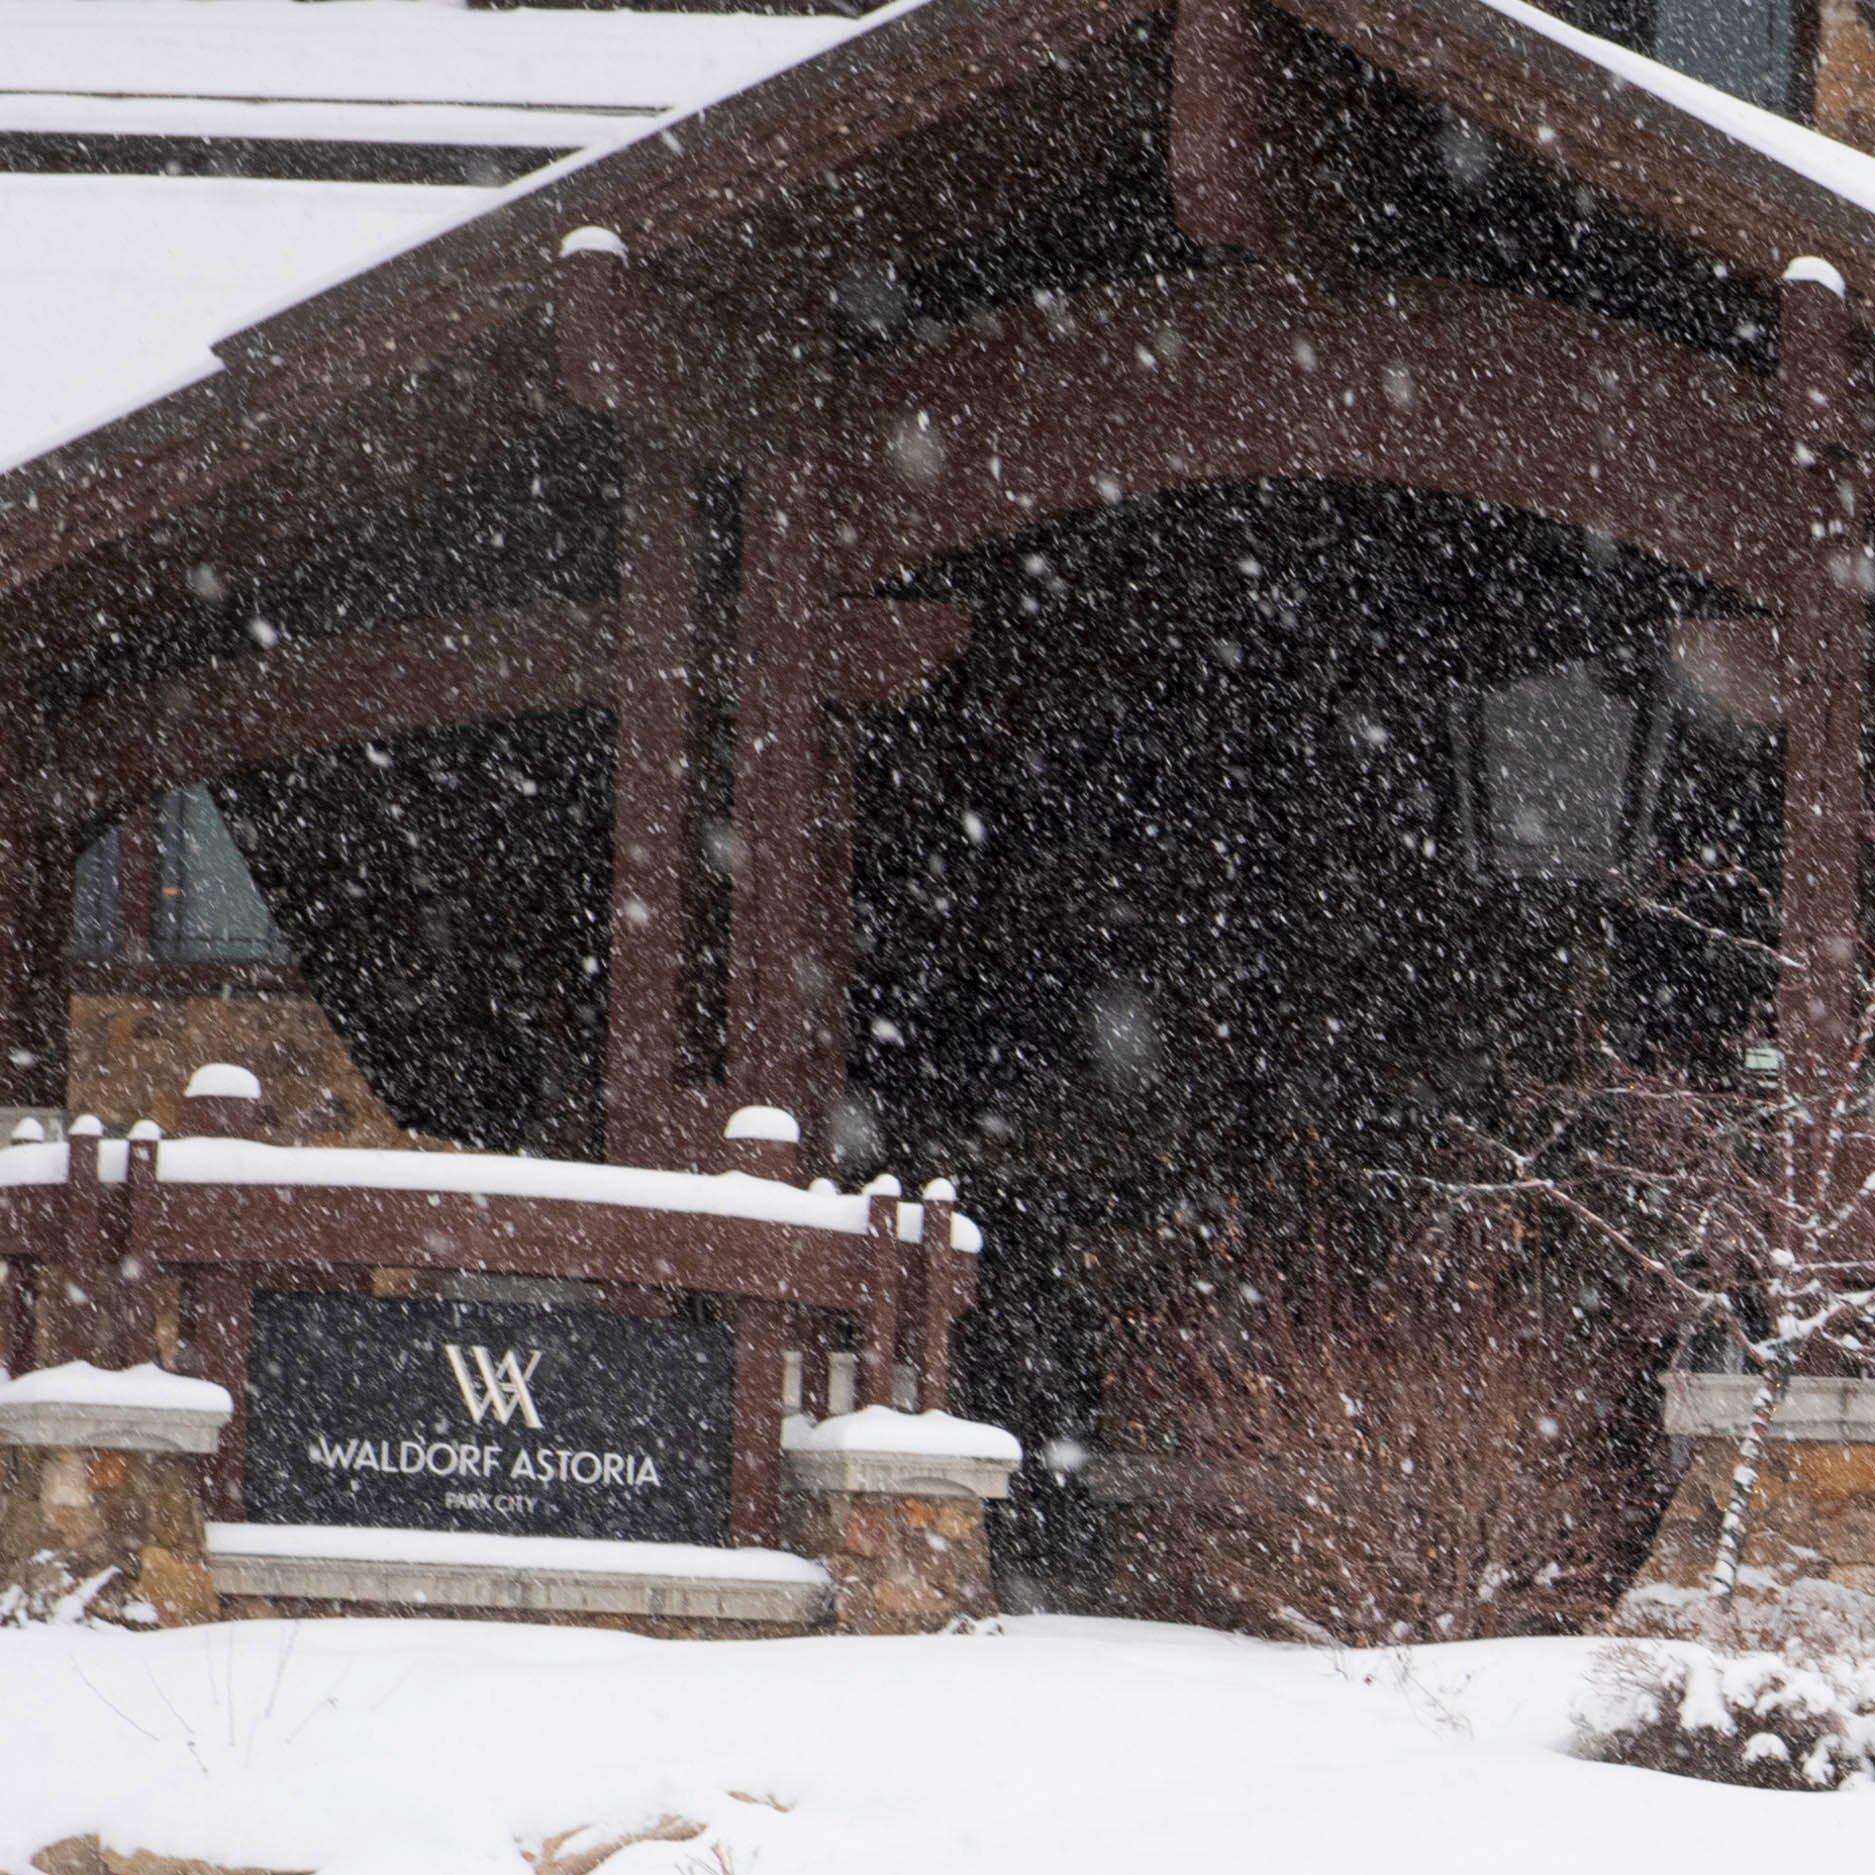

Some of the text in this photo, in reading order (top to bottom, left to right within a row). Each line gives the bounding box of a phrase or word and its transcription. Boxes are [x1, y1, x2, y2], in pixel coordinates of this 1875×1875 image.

[318, 1436, 662, 1488] WALDORF ASTORIA
[445, 1492, 539, 1516] PARK CITY
